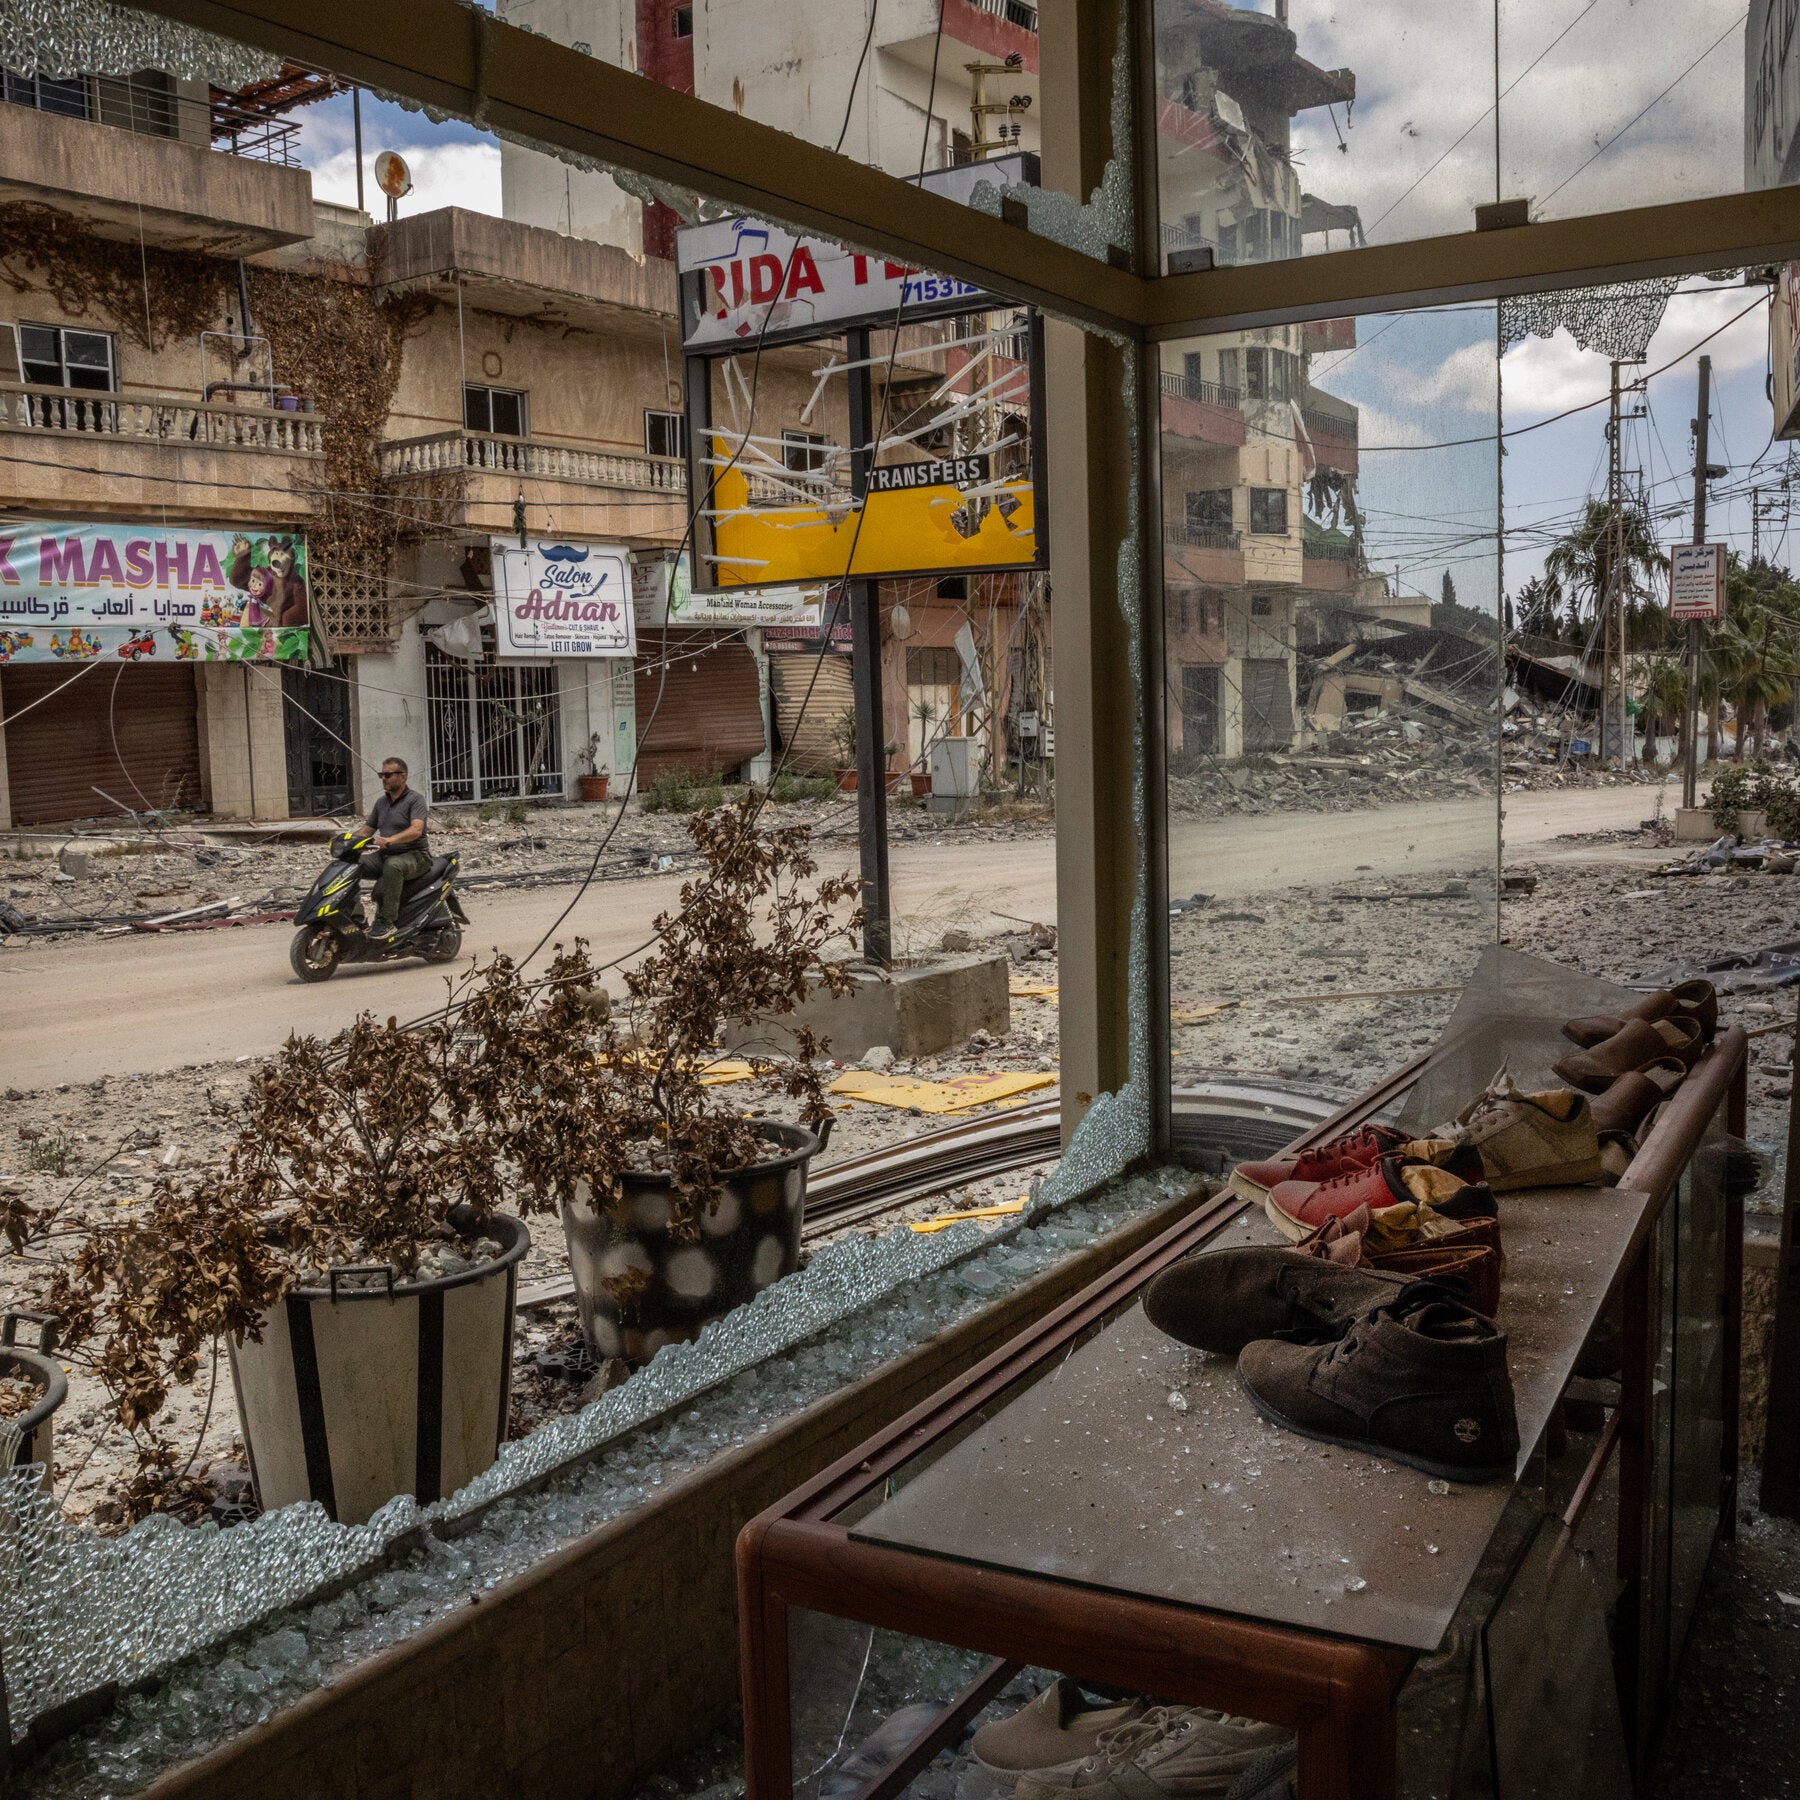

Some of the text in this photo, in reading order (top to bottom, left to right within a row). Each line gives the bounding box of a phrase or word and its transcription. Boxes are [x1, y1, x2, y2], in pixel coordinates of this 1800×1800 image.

[866, 457, 981, 490] TRANSFERS
[39, 536, 226, 591] MASHA
[1676, 547, 1715, 560] مركز نصر
[539, 564, 593, 589] Salon
[92, 593, 134, 620] ألعاب
[154, 599, 196, 622] هدايا
[514, 588, 621, 622] Adnan
[706, 598, 721, 608] Man
[734, 600, 757, 610] Woman
[758, 600, 793, 611] Accessories
[551, 641, 592, 653] LET IT GROW
